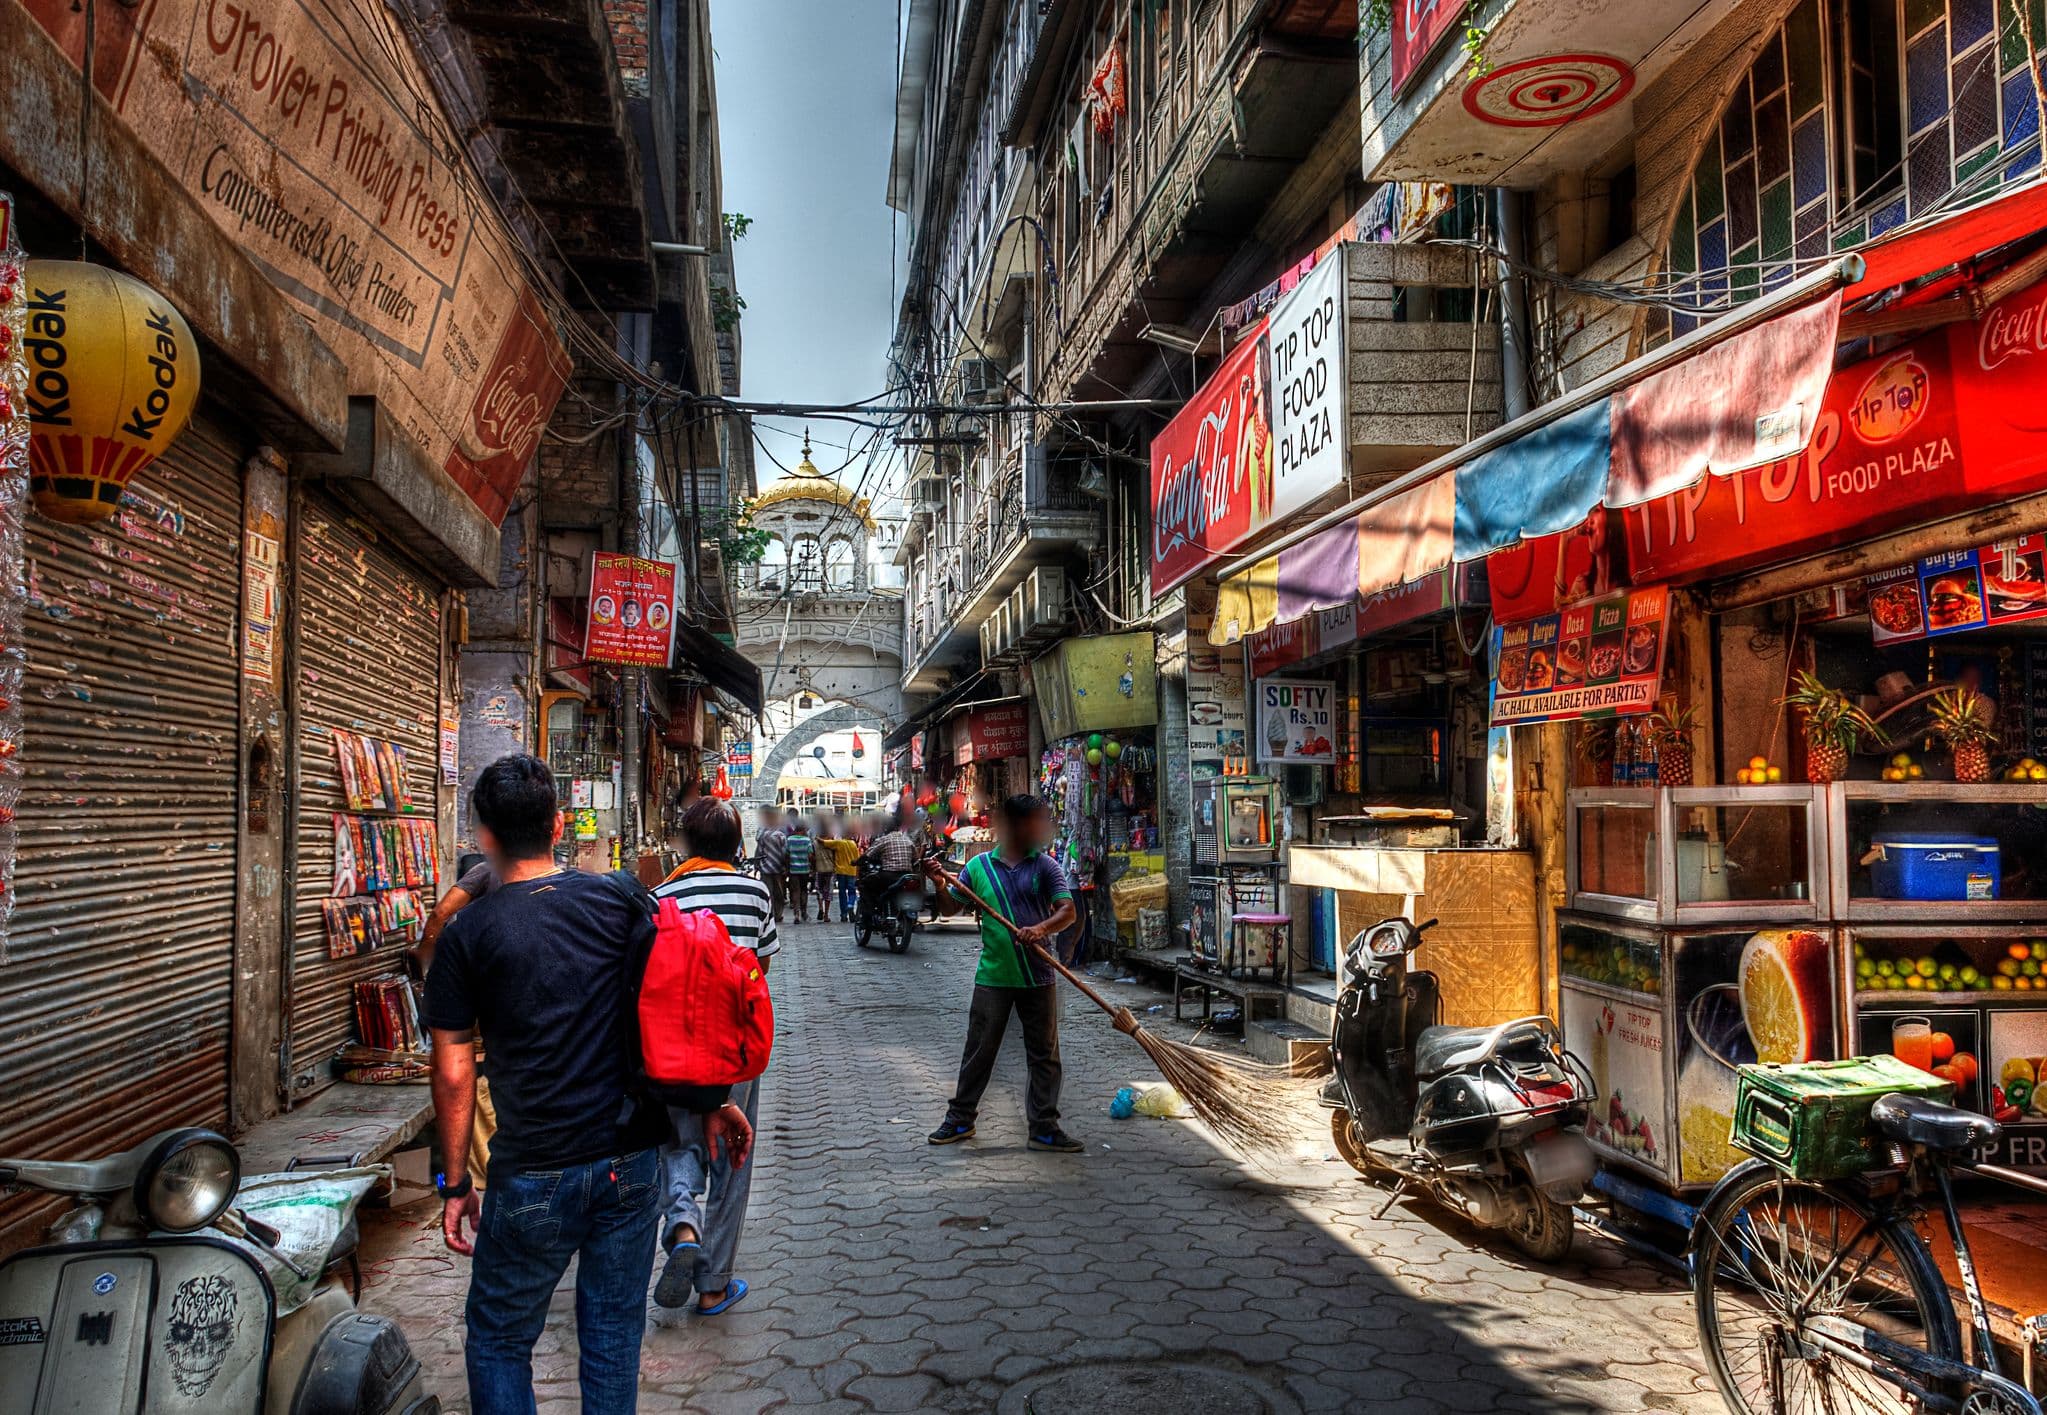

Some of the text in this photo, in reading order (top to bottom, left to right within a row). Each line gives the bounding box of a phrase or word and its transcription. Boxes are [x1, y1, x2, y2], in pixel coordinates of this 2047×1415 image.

[207, 0, 458, 257] Grover Printing Press
[365, 262, 417, 328] Printers
[27, 288, 72, 426] Kodak
[1275, 296, 1333, 382] TIP TOP
[122, 307, 175, 441] Kodak
[1283, 357, 1327, 426] FOOD
[1281, 406, 1332, 477] PLAZA
[1851, 397, 1882, 427] TIP
[1156, 390, 1234, 563] Coca-Cola
[1827, 437, 1955, 499] FOOD PLAZA
[1503, 599, 1660, 647] Noodles Burger Dosa Pizza Coffee
[1266, 686, 1328, 709] SOFTY
[1498, 683, 1648, 716] AC HALL AVAILABLE FOR PARTIES
